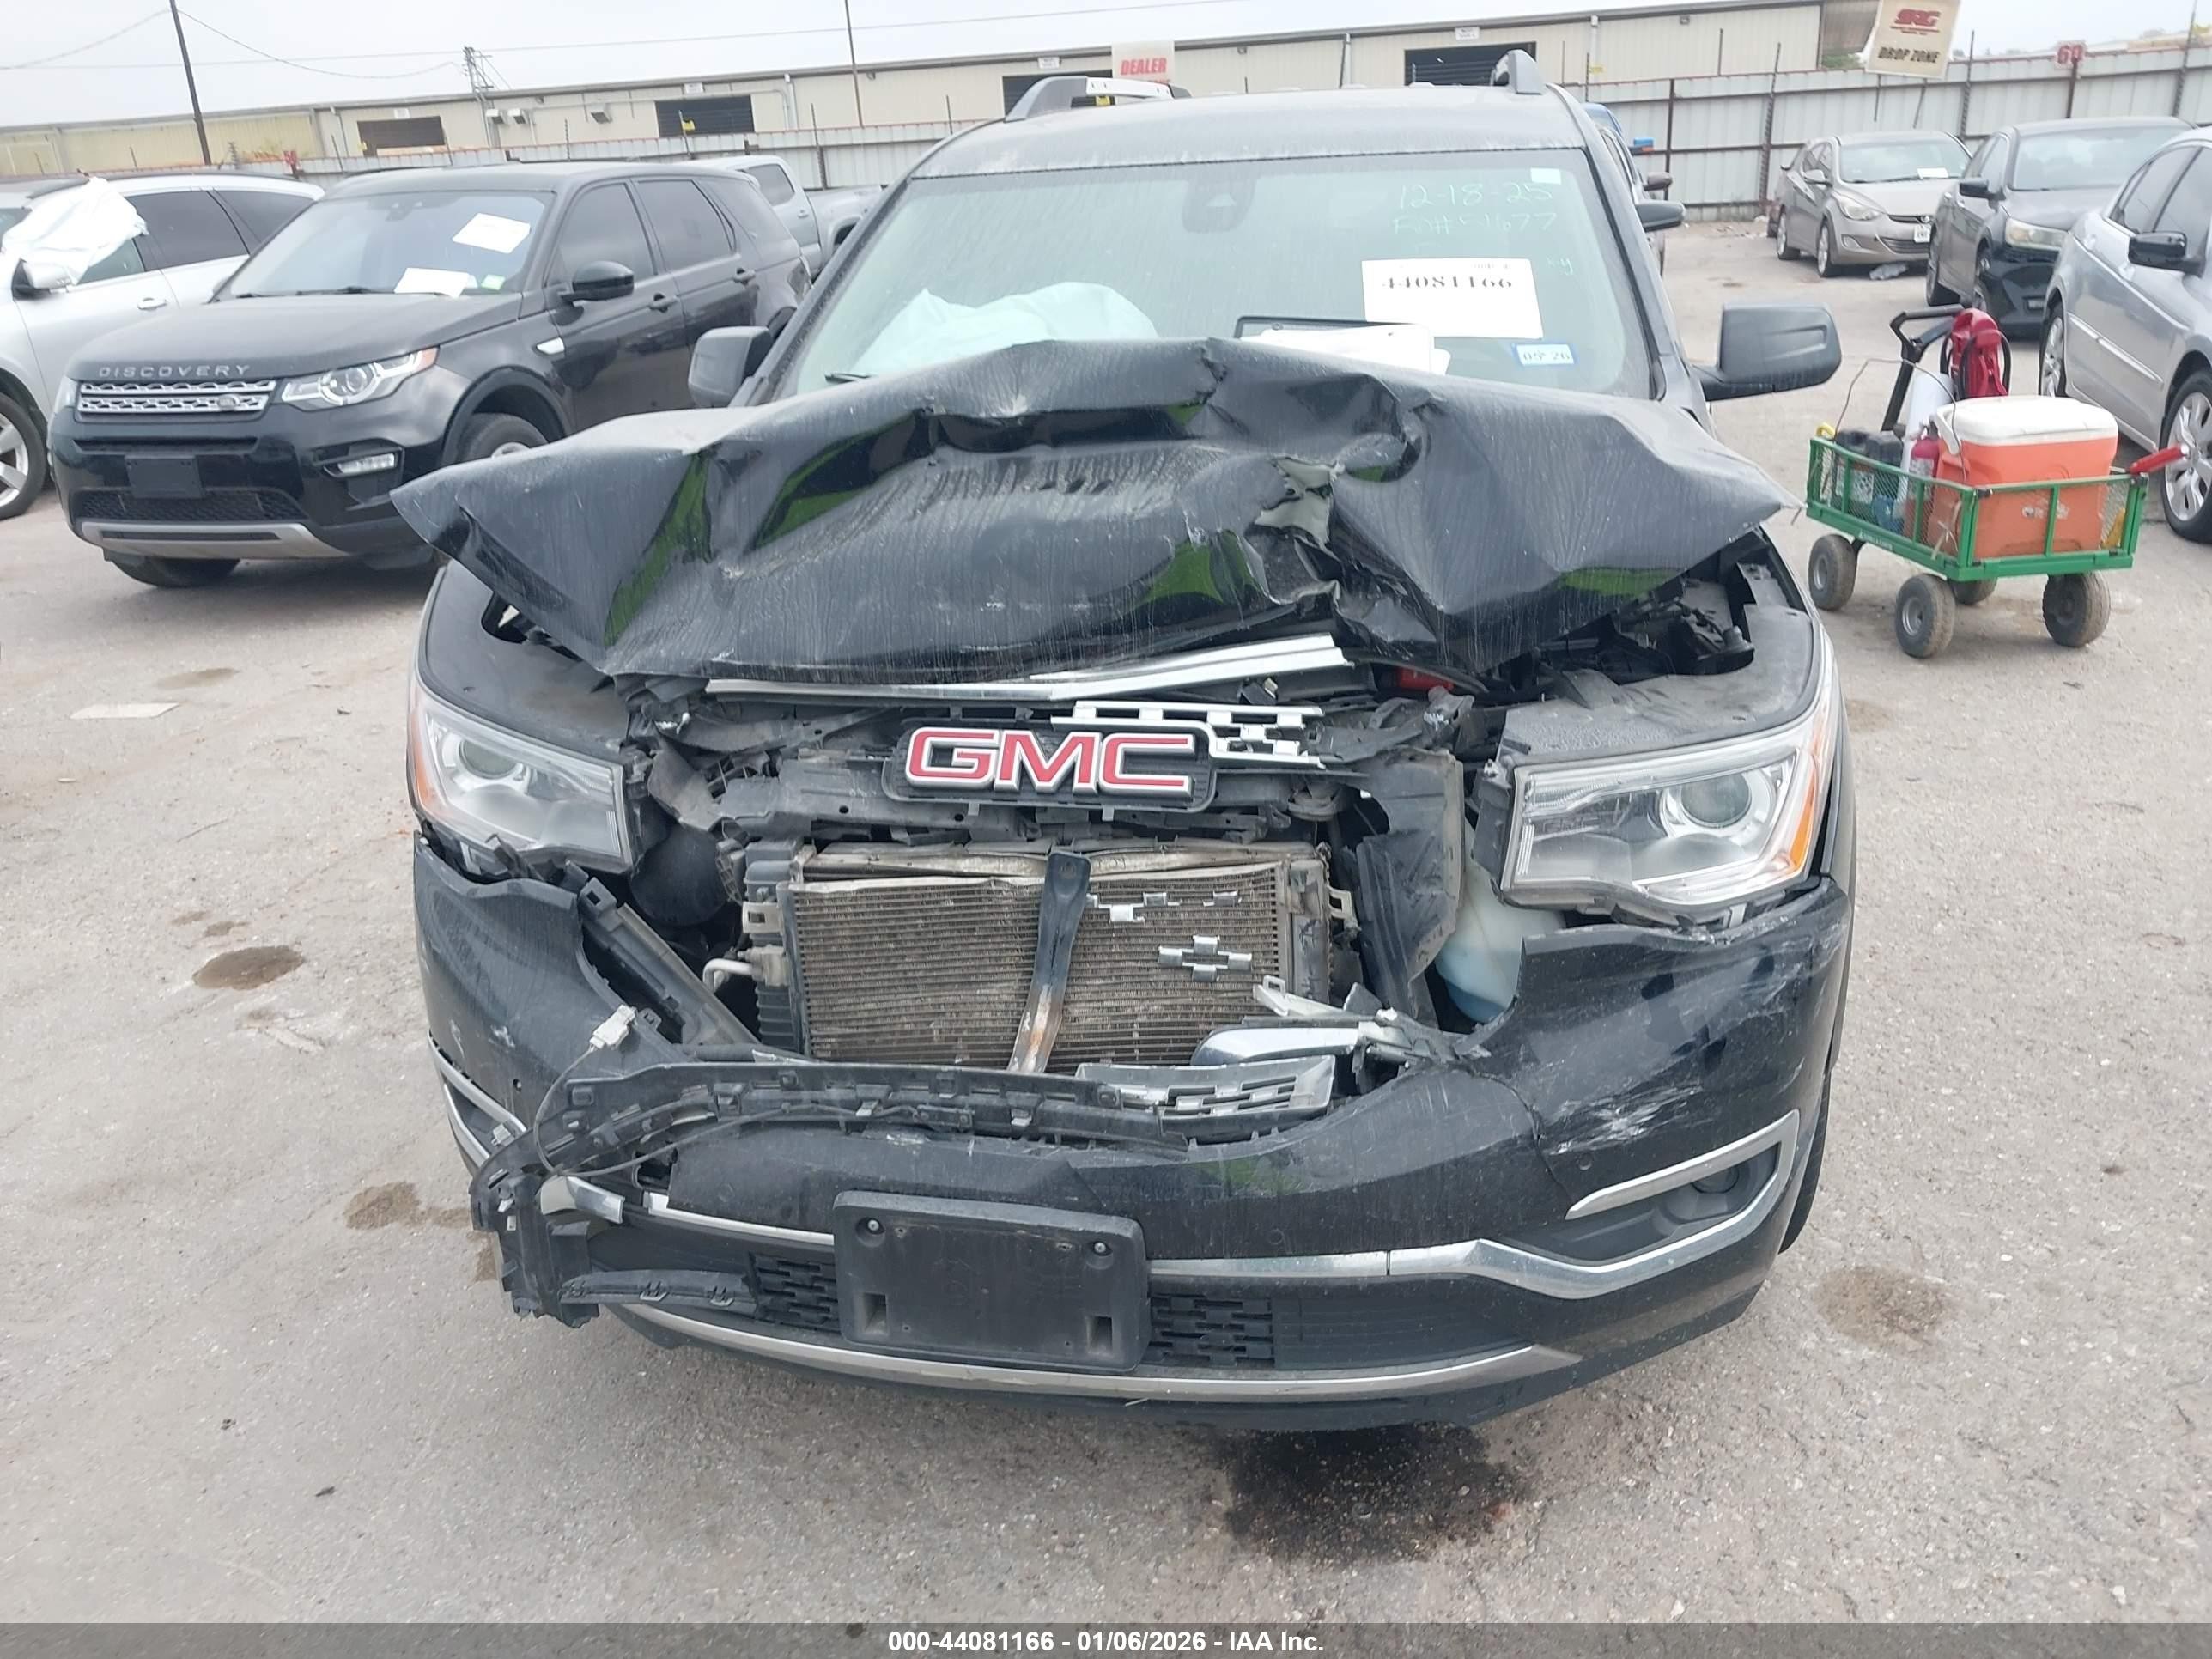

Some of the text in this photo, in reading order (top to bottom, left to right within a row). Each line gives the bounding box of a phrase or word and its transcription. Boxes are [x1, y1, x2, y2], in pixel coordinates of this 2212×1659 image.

[1878, 46, 1941, 63] DROP ZONE
[1121, 58, 1167, 76] DEALER
[1382, 276, 1512, 289] 44081166
[99, 365, 250, 378] DISCOVERY
[905, 727, 1194, 799] GMC
